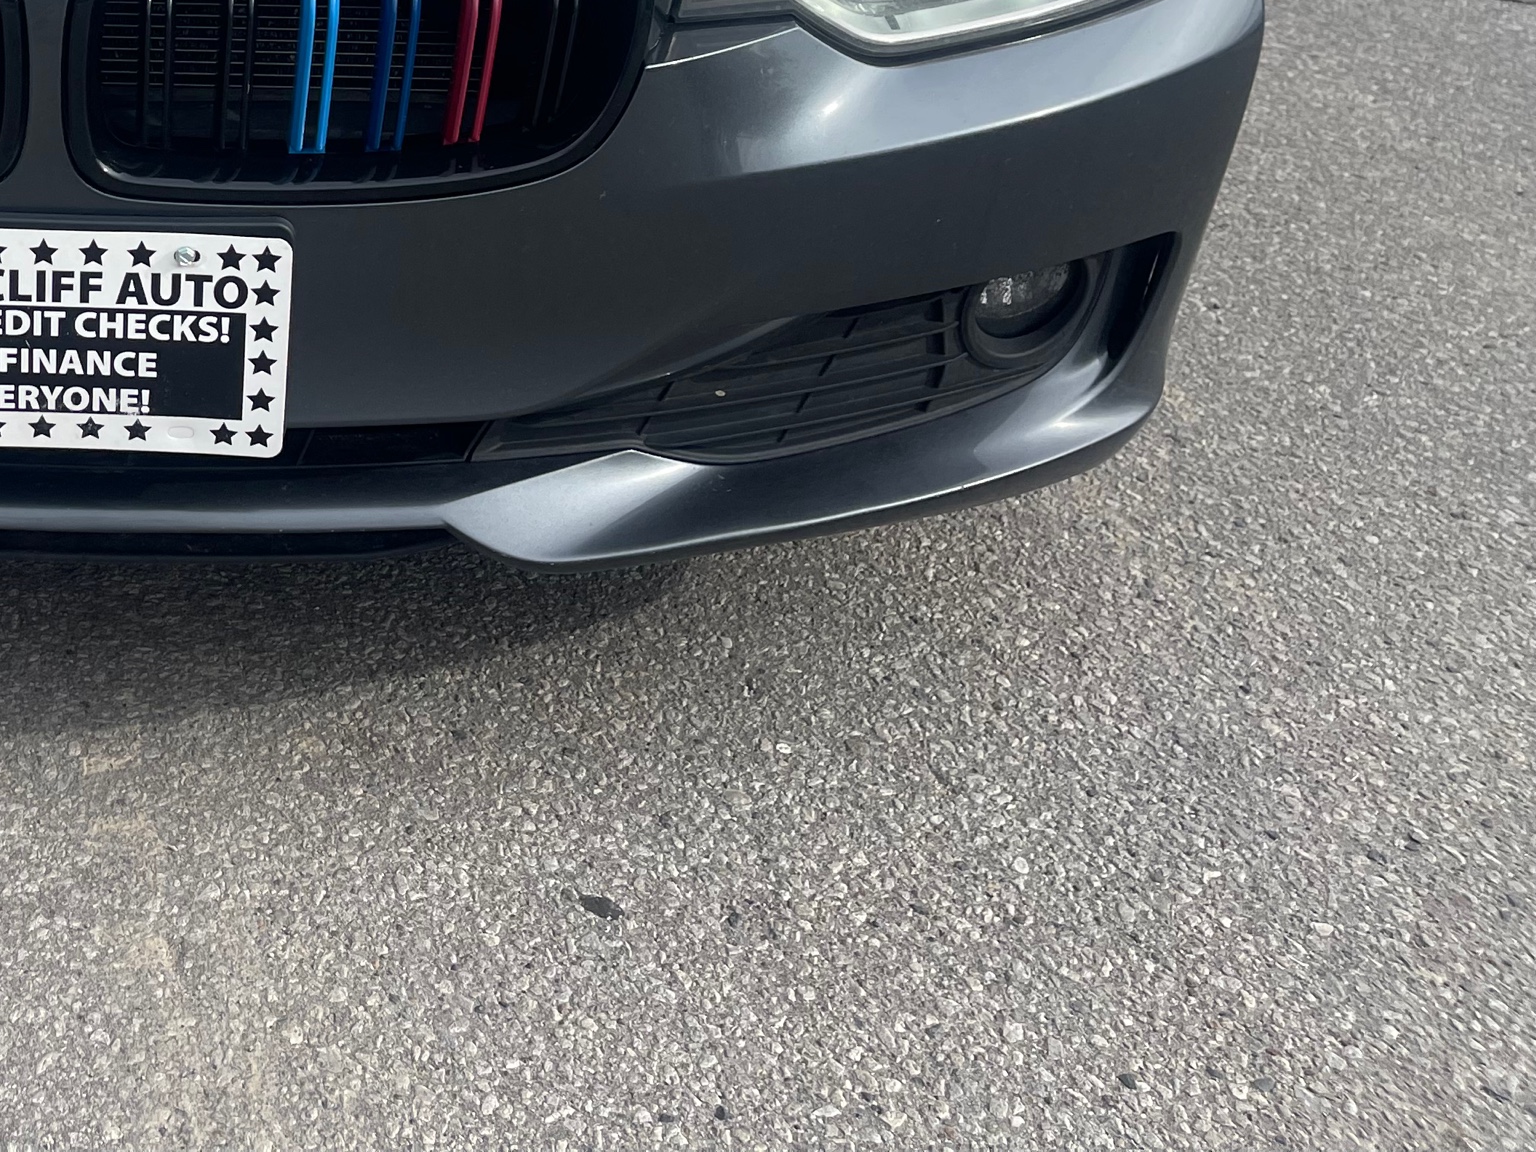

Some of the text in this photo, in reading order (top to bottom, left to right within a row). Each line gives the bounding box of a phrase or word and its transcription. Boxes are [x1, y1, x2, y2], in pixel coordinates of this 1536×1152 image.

[117, 272, 249, 309] AUTO
[75, 311, 231, 344] CHECKS!
[0, 348, 158, 378] FINANCE
